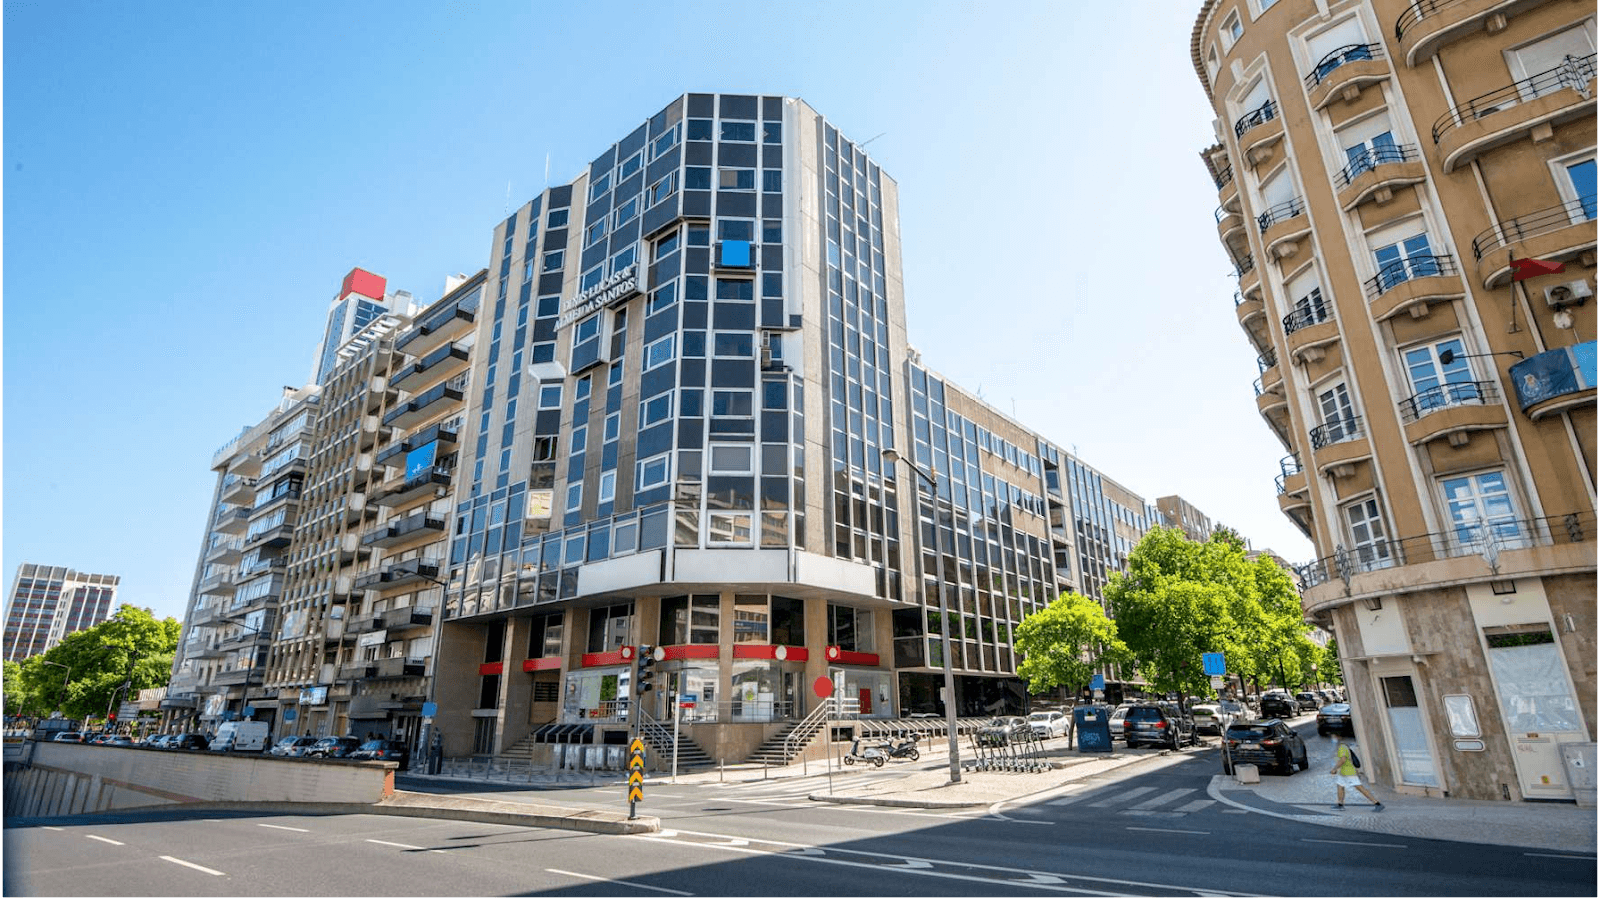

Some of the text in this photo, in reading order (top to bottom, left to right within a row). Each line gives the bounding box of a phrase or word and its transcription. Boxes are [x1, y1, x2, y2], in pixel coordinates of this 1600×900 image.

[563, 266, 632, 313] DINIS LUCAS &
[595, 277, 635, 307] SANTOS
